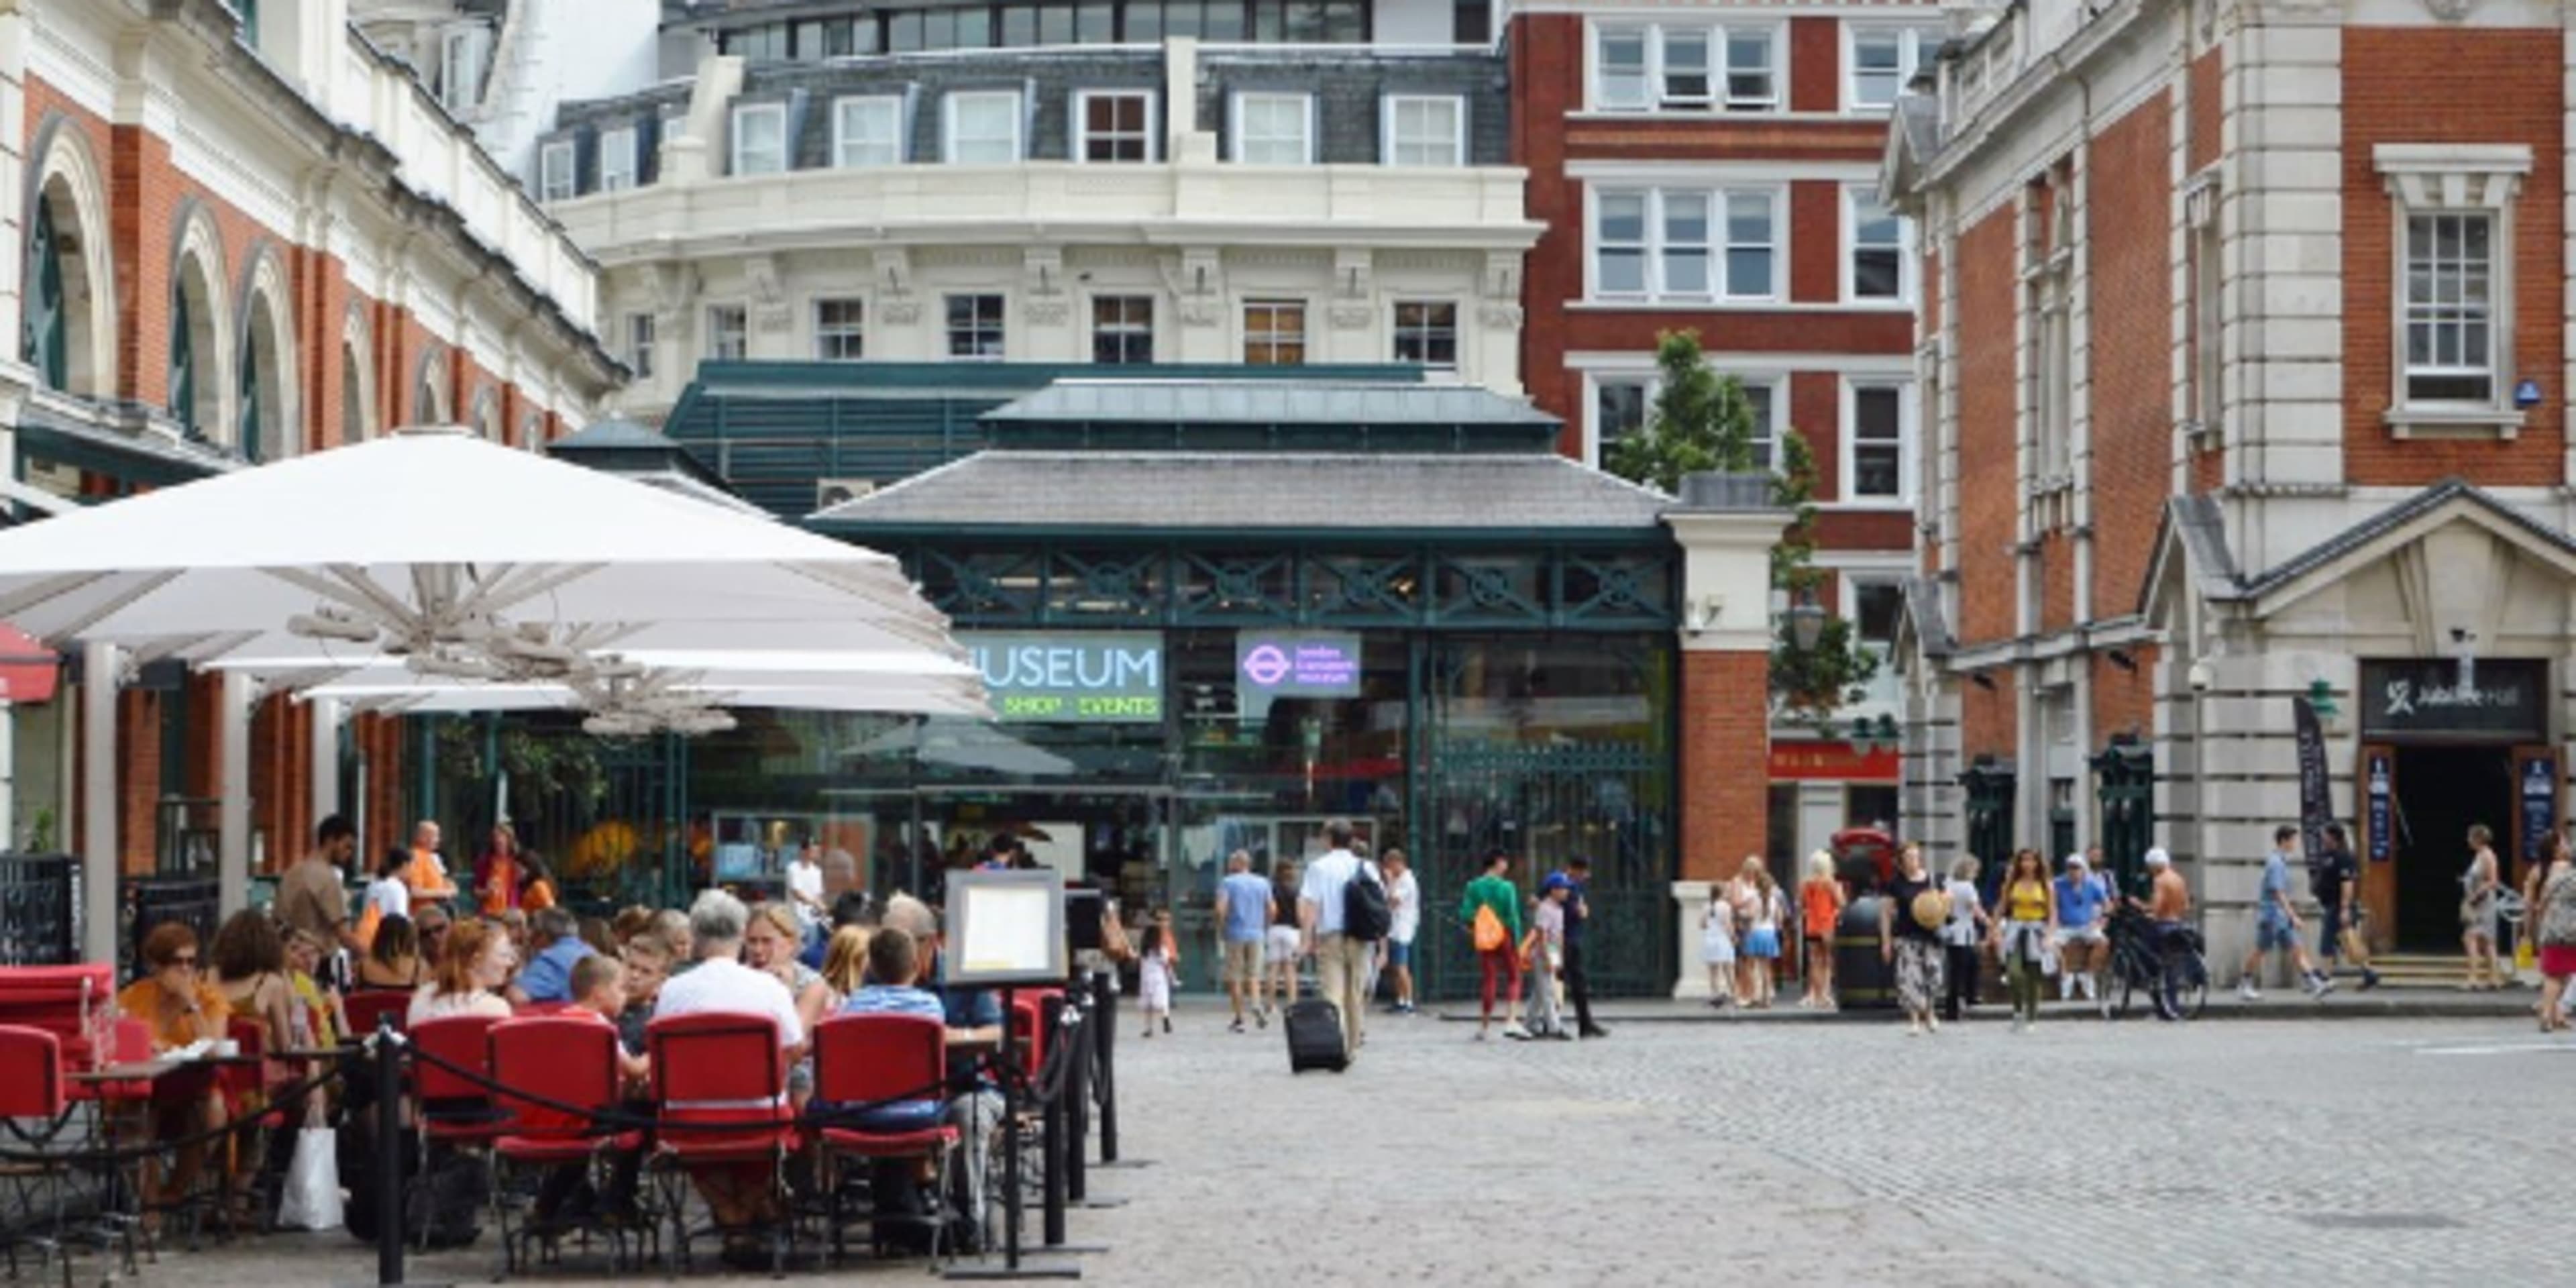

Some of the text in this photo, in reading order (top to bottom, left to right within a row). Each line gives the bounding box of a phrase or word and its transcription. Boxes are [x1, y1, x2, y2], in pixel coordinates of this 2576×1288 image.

[970, 645, 1158, 687] USEUM
[1004, 696, 1157, 715] SHOP EVENTS
